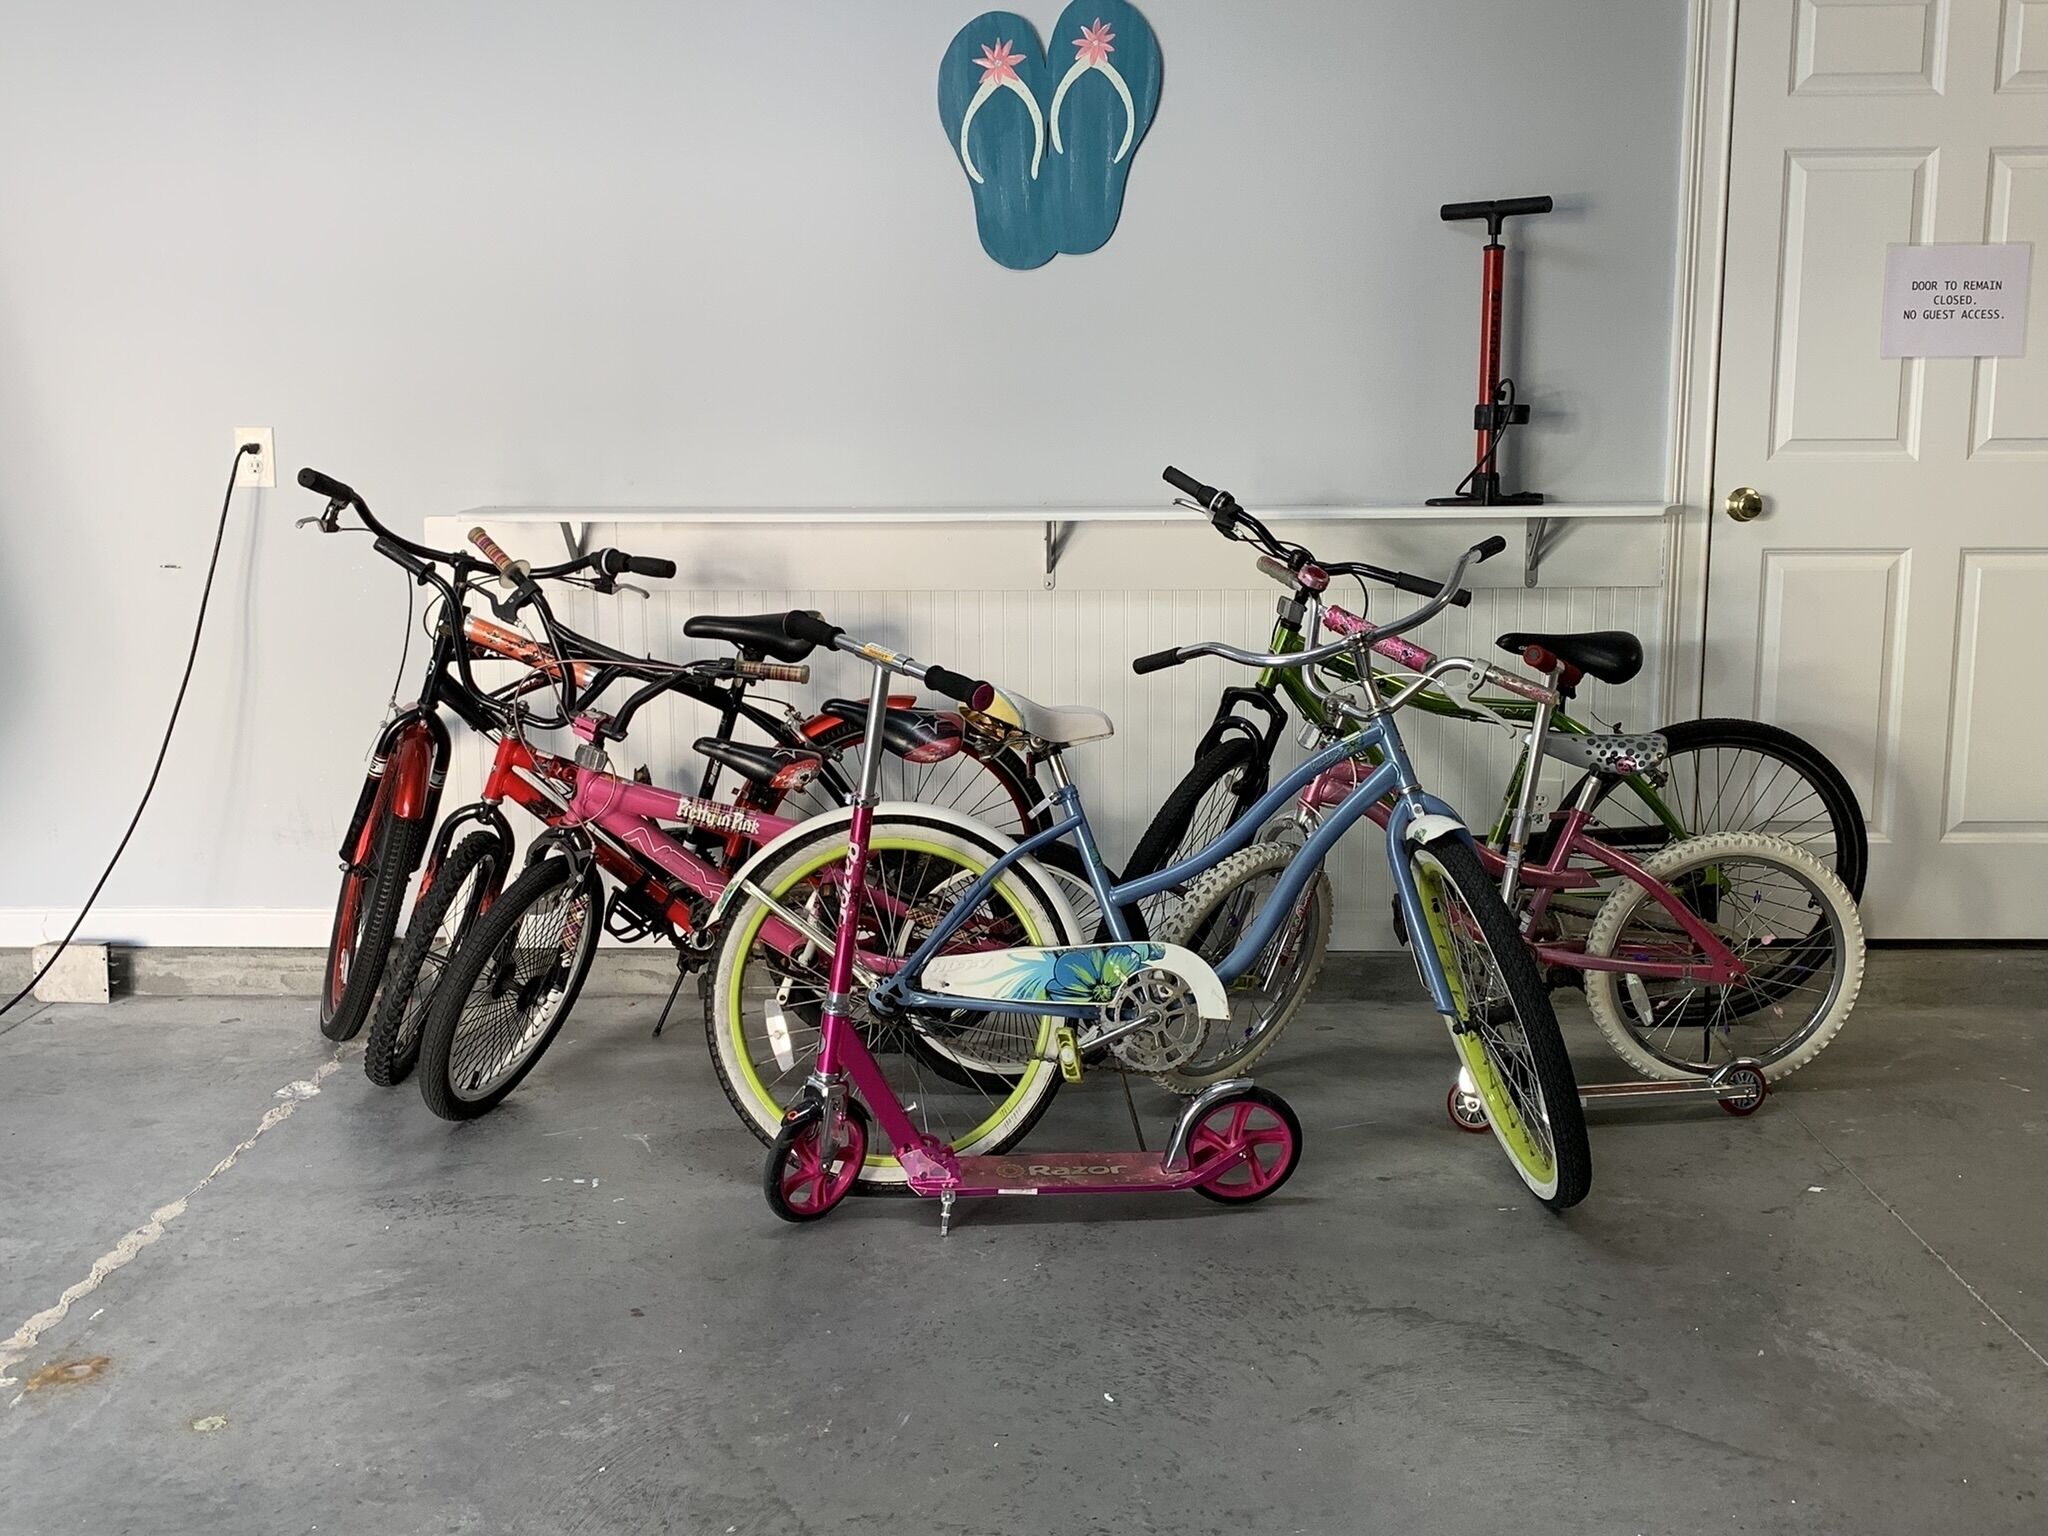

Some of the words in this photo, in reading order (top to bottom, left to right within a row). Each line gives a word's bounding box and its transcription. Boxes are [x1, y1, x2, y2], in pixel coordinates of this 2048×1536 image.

[1911, 280, 1938, 291] DOOR
[1944, 280, 1958, 291] TO
[1963, 280, 2003, 291] REMAIN
[1933, 294, 1978, 306] CLOSED.
[1903, 309, 1917, 320] NO
[1922, 309, 1956, 320] GUEST
[1961, 309, 2006, 320] ACCESS.
[730, 811, 760, 835] Pink
[1029, 1164, 1128, 1176] Razor
